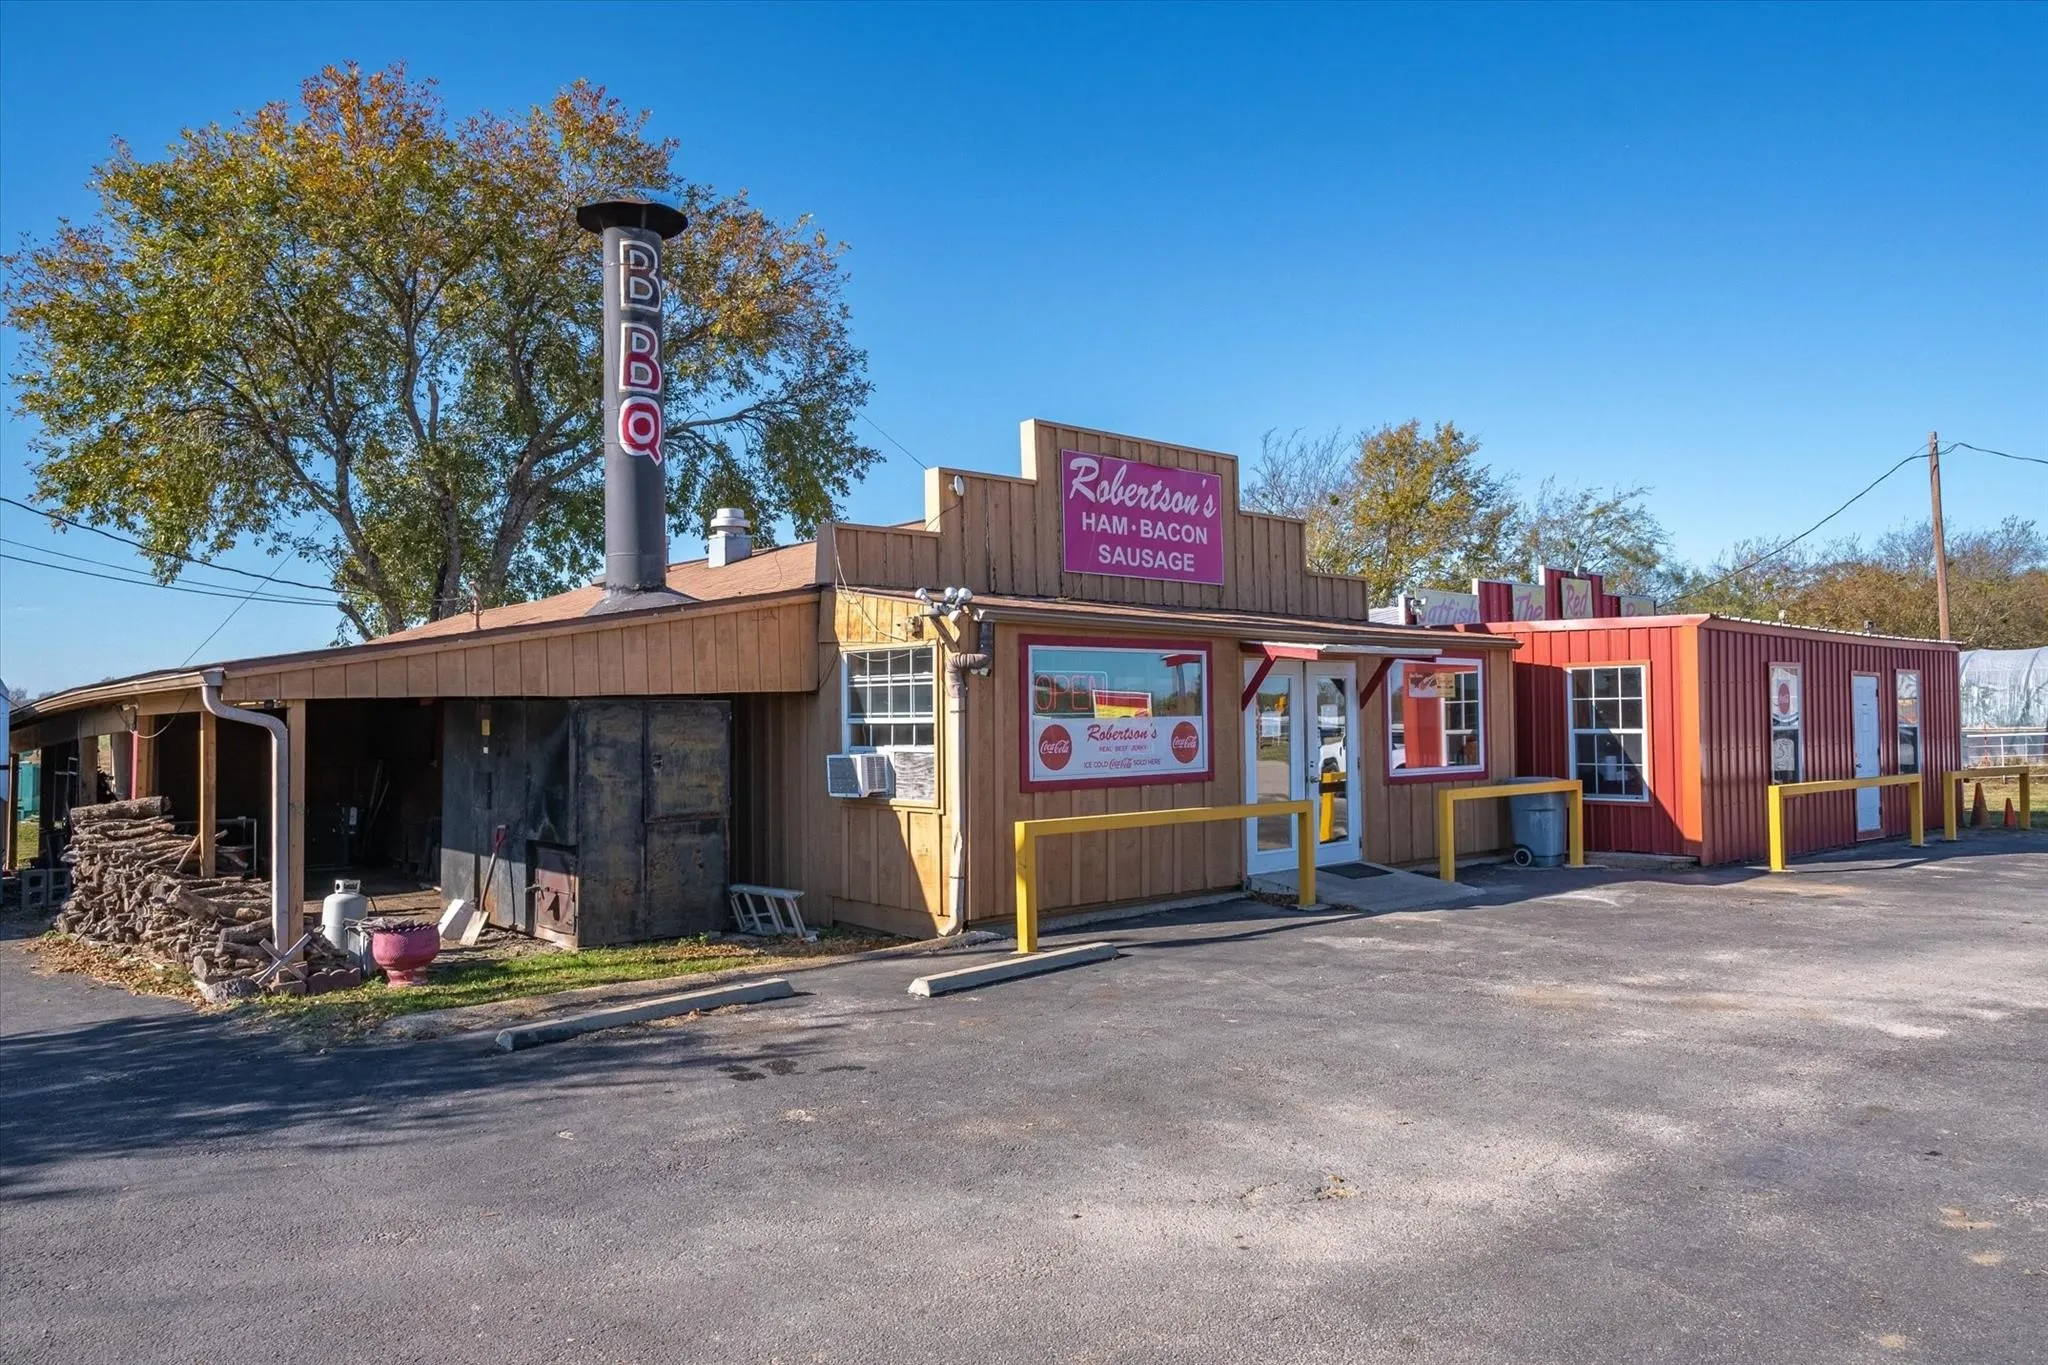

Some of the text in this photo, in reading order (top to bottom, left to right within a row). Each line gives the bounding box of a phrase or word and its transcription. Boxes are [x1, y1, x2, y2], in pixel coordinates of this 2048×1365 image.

[619, 238, 662, 466] BBQ
[1069, 457, 1216, 518] Robertson's
[1082, 511, 1208, 545] HAM BACON
[1098, 544, 1195, 572] SAUSAGE
[1514, 592, 1543, 620] The
[1565, 583, 1590, 617] Red
[1035, 674, 1105, 711] OPEN
[1087, 723, 1158, 742] Robertson's
